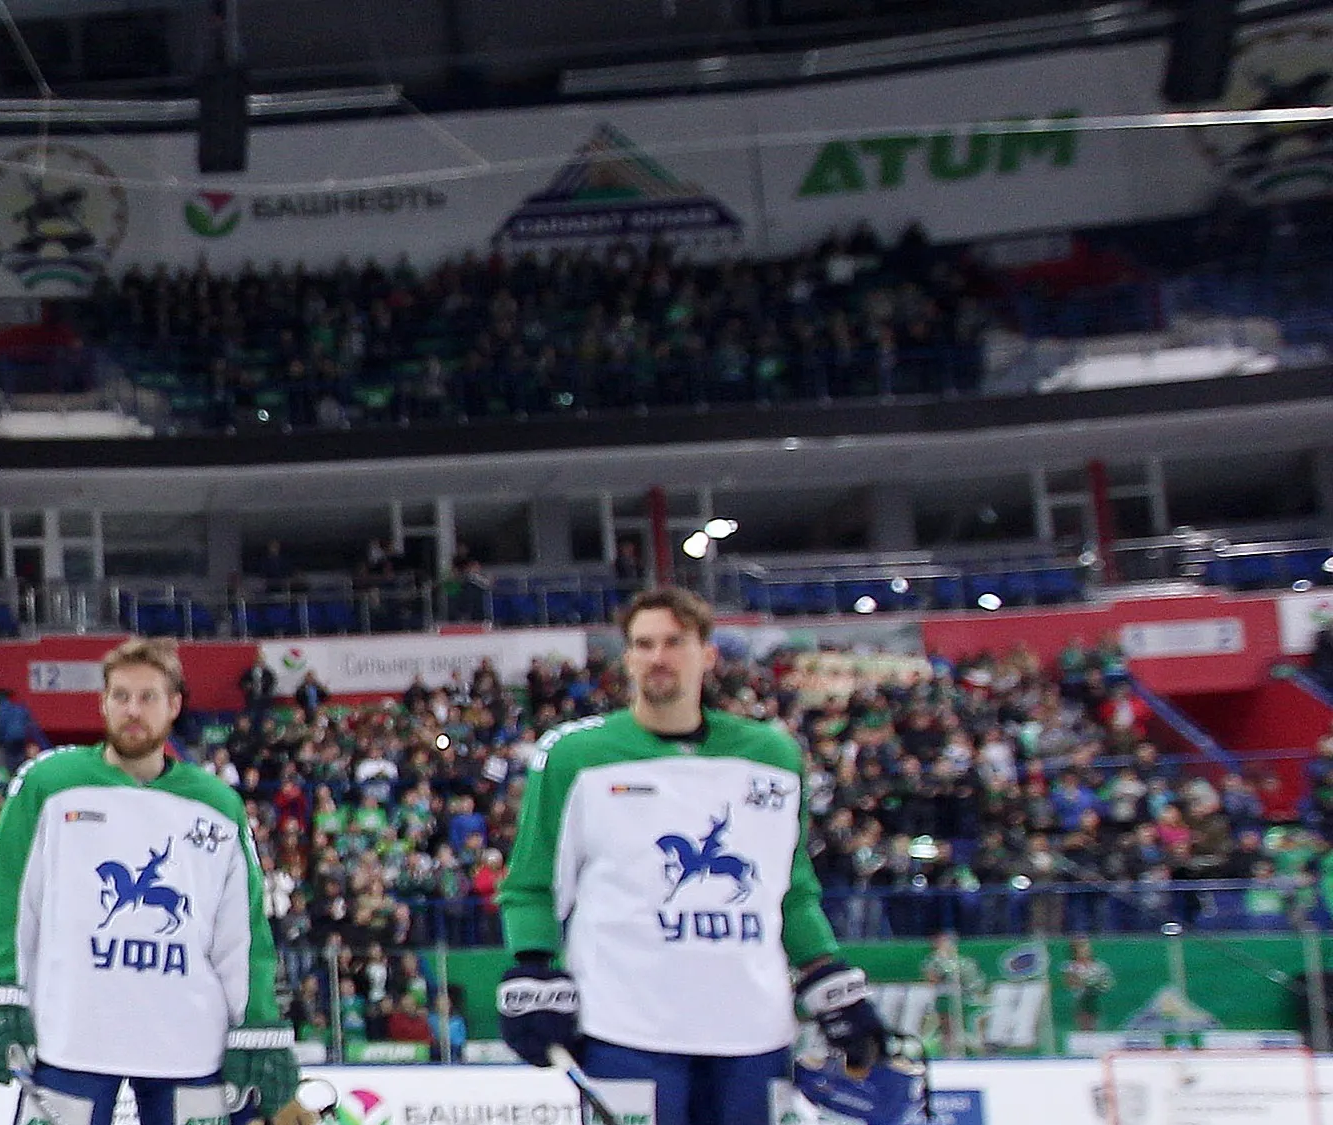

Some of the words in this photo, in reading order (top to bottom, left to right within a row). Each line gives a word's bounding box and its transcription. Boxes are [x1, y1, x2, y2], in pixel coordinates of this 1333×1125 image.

[797, 109, 1082, 197] ATUM
[252, 185, 448, 218] БАШНЕФТЬ
[658, 911, 762, 942] УФА
[90, 936, 187, 976] УФА
